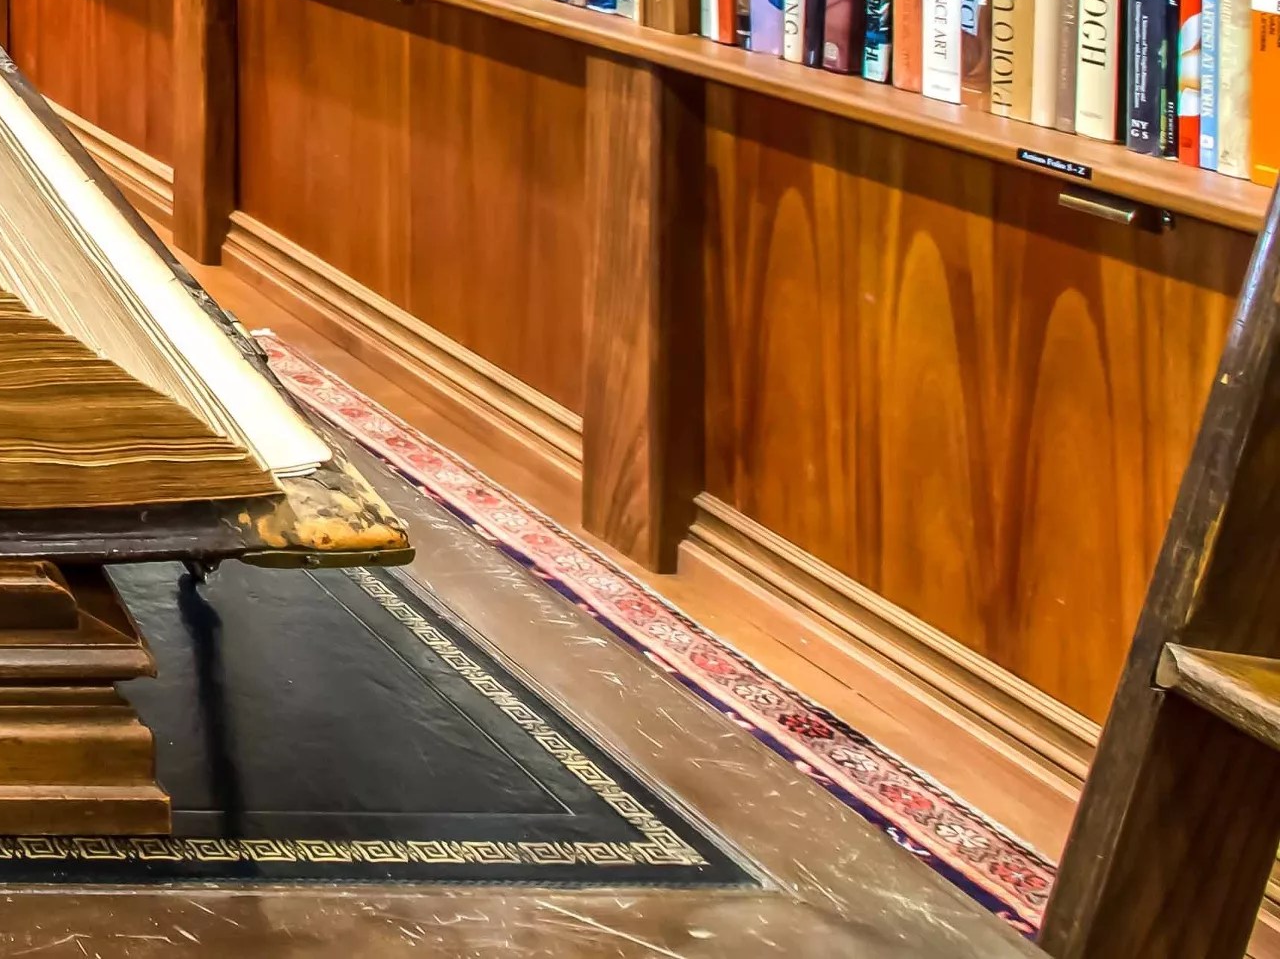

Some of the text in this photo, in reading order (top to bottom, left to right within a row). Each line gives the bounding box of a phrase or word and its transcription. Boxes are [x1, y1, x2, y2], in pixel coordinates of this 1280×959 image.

[932, 28, 947, 59] ART
[991, 23, 1014, 108] PAOLO
[1201, 0, 1215, 119] ARTIST AT WORK
